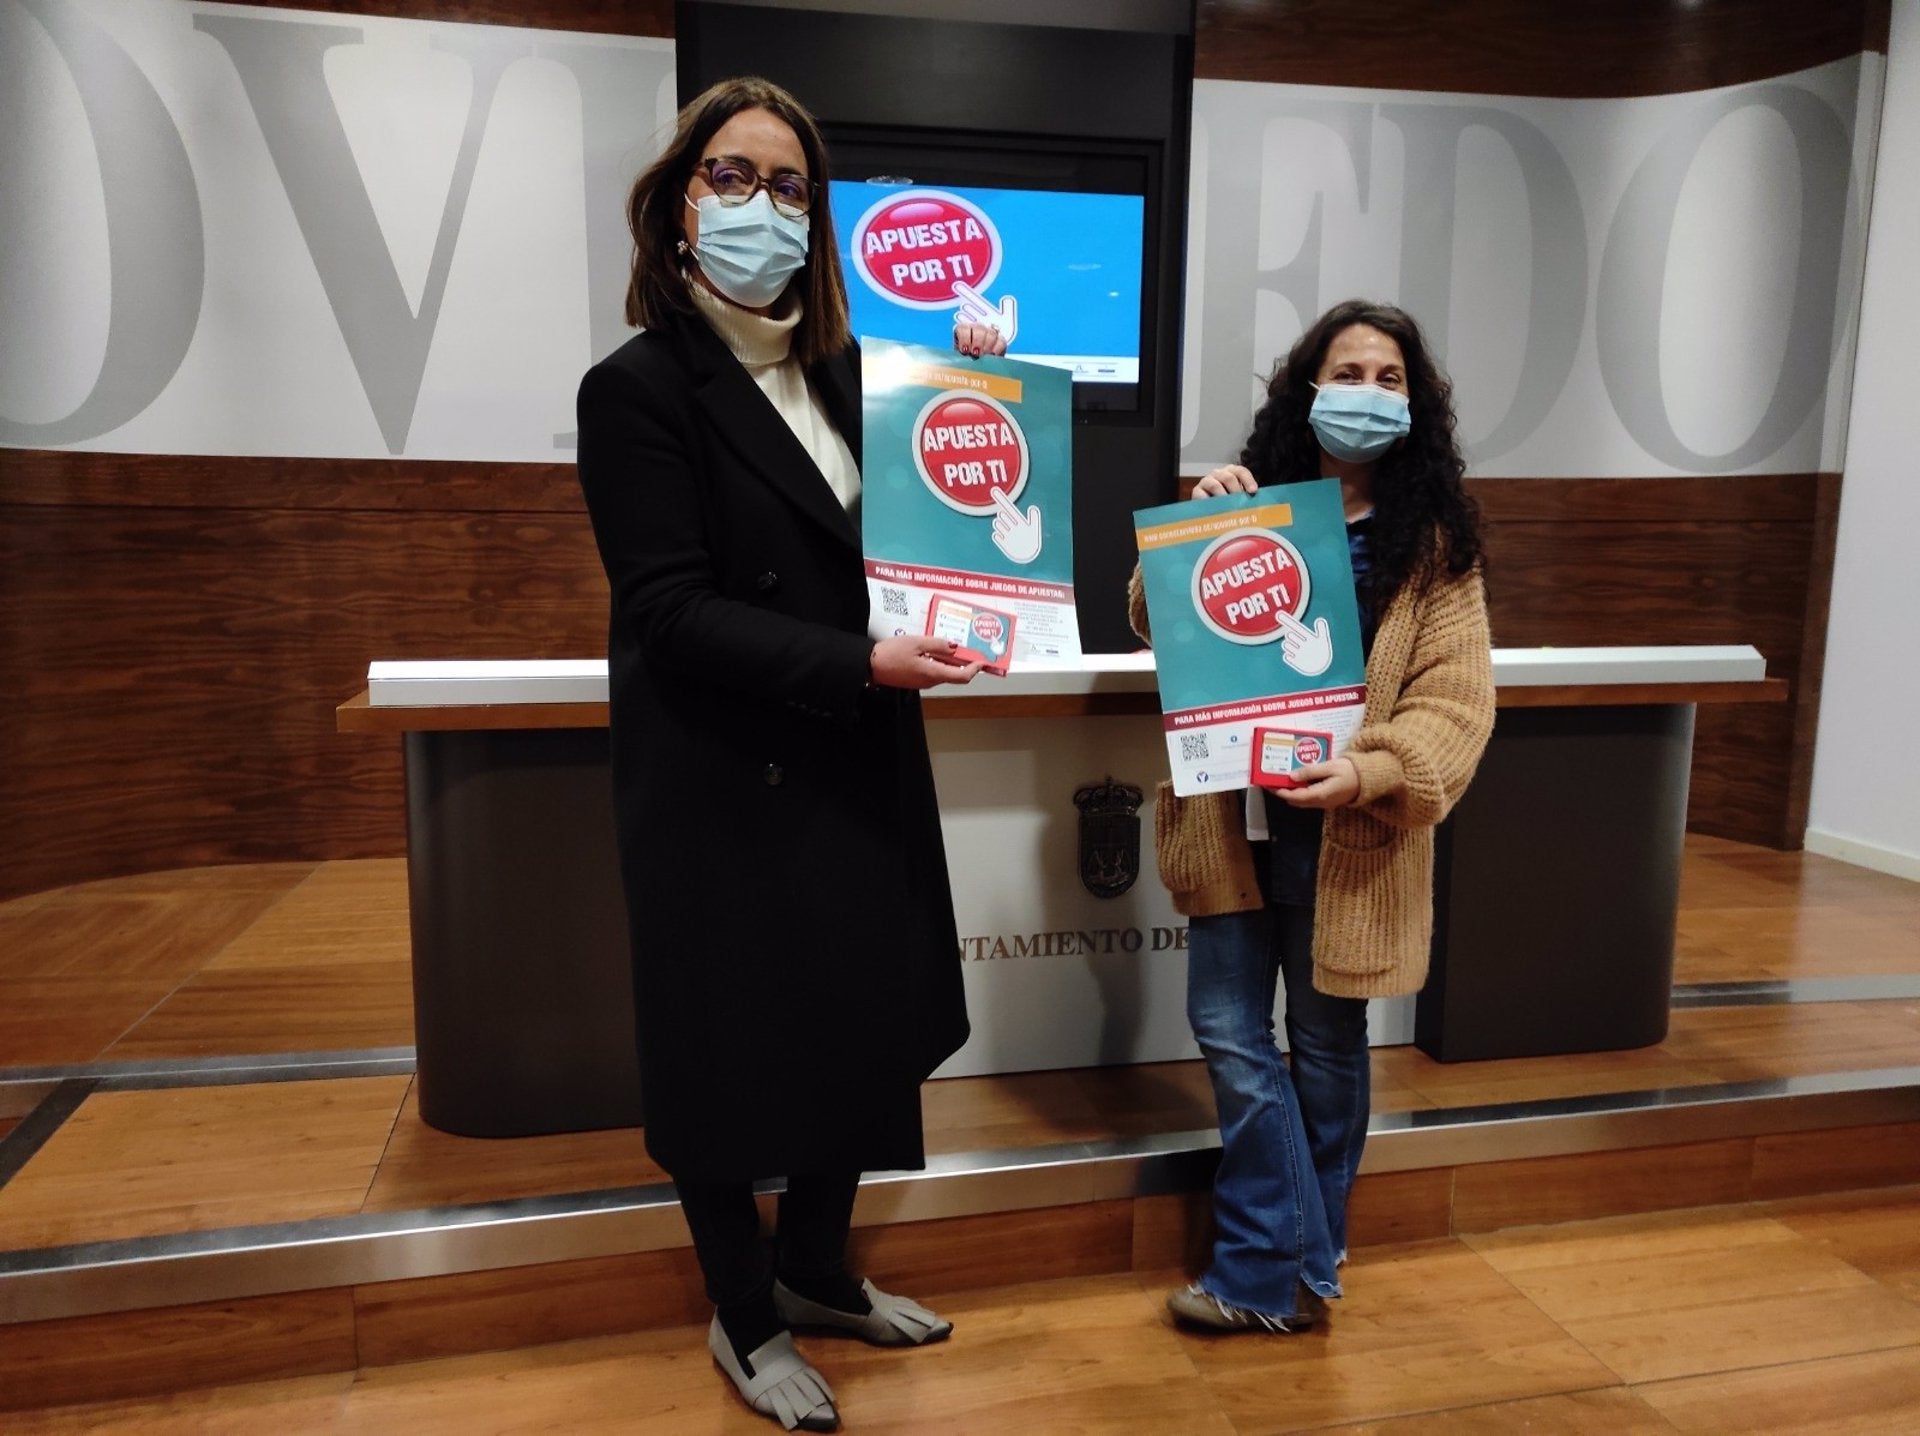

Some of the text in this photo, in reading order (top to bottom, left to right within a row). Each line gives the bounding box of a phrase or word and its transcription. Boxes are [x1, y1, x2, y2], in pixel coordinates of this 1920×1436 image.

[866, 217, 984, 255] APUESTA
[891, 254, 975, 286] POR TI
[924, 422, 1015, 452] APUESTA
[944, 459, 1008, 487] POR TI
[875, 566, 895, 578] PARA
[895, 568, 913, 580] MÁS
[913, 572, 964, 587] INFORMACIÓN
[965, 578, 989, 590] SOBRE
[990, 582, 1017, 594] JUEGOS
[1017, 585, 1027, 595] DE
[1200, 547, 1294, 599] APUESTA
[1225, 583, 1291, 625] POR TI
[1174, 714, 1195, 726] PARA
[1195, 711, 1212, 722] MÁS
[1212, 704, 1262, 719] INFORMACIÓN
[1262, 701, 1287, 712] SOBRE
[1287, 697, 1314, 709] JUEGOS
[1314, 696, 1325, 705] DE
[1151, 926, 1189, 951] DE
